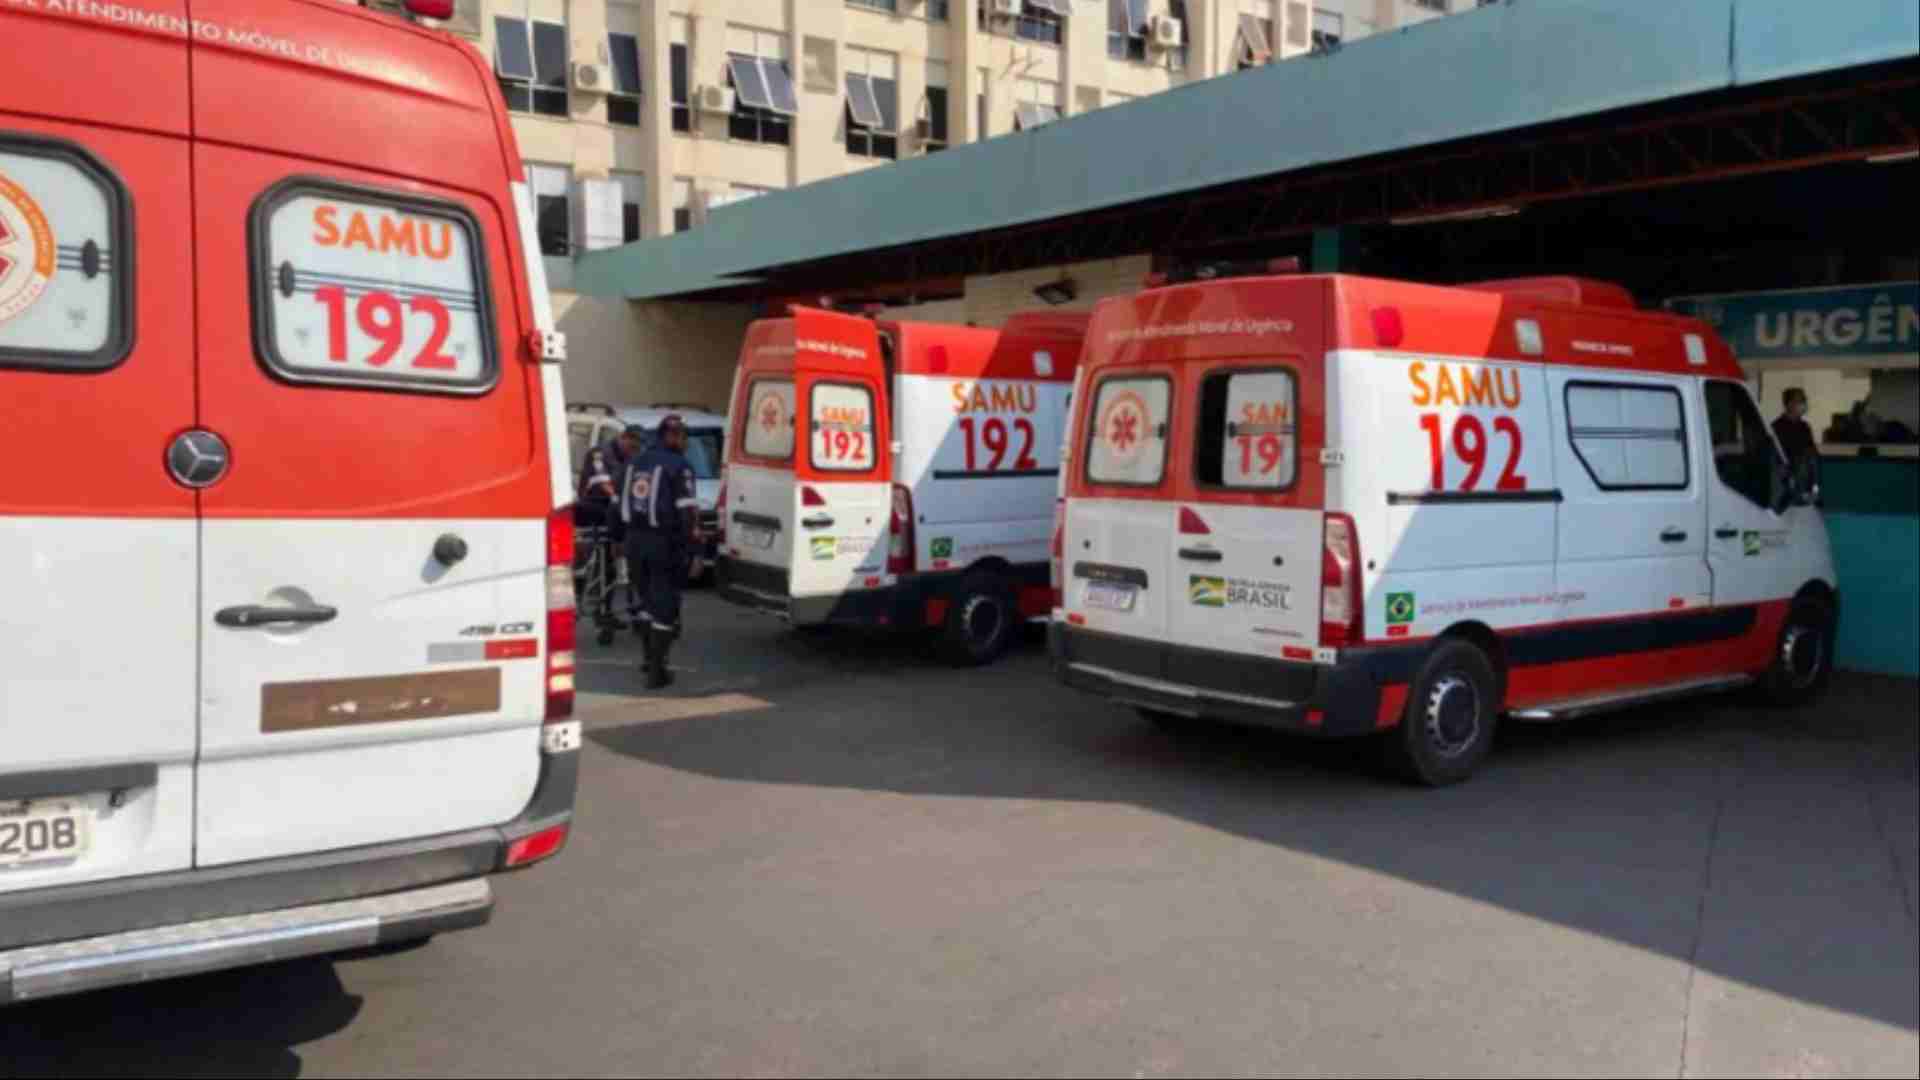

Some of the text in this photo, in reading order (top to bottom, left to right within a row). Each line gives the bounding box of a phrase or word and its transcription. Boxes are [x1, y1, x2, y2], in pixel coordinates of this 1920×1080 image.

[45, 0, 221, 40] ATENDIMENTO
[311, 204, 454, 261] SAMU
[314, 283, 458, 371] 192
[951, 382, 1038, 414] SAMU
[1408, 360, 1521, 410] SAMU
[821, 430, 866, 461] 192
[957, 416, 1039, 472] 192
[1237, 432, 1283, 475] 19
[1418, 413, 1528, 491] 192
[1226, 586, 1292, 610] BRASIL
[0, 817, 76, 855] 208
